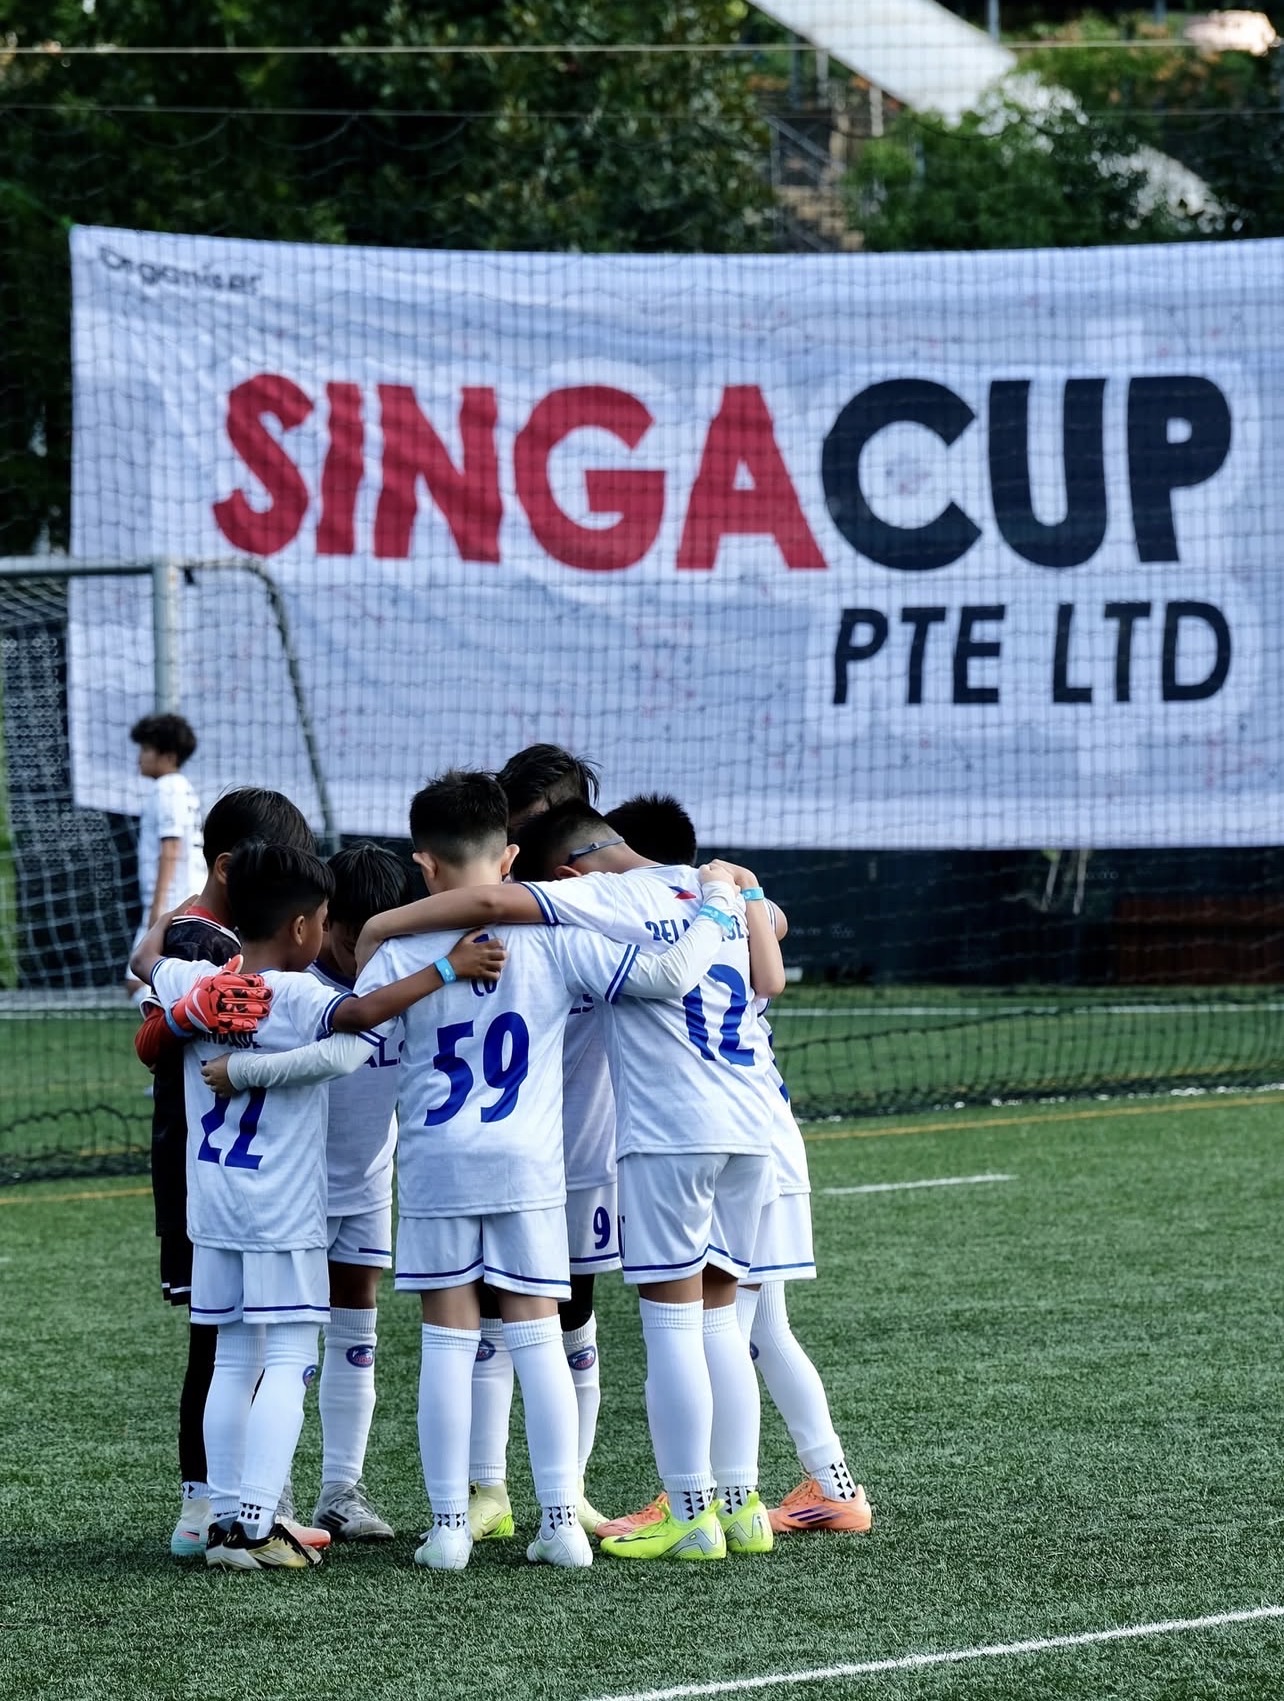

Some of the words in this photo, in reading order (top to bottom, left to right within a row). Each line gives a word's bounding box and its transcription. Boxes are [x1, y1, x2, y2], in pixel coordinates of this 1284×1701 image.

[98, 247, 262, 295] Organiser
[834, 602, 1003, 705] PTE
[1054, 601, 1232, 704] LTD
[682, 963, 756, 1067] 12
[424, 1011, 530, 1127] 59
[593, 1206, 611, 1250] 9
